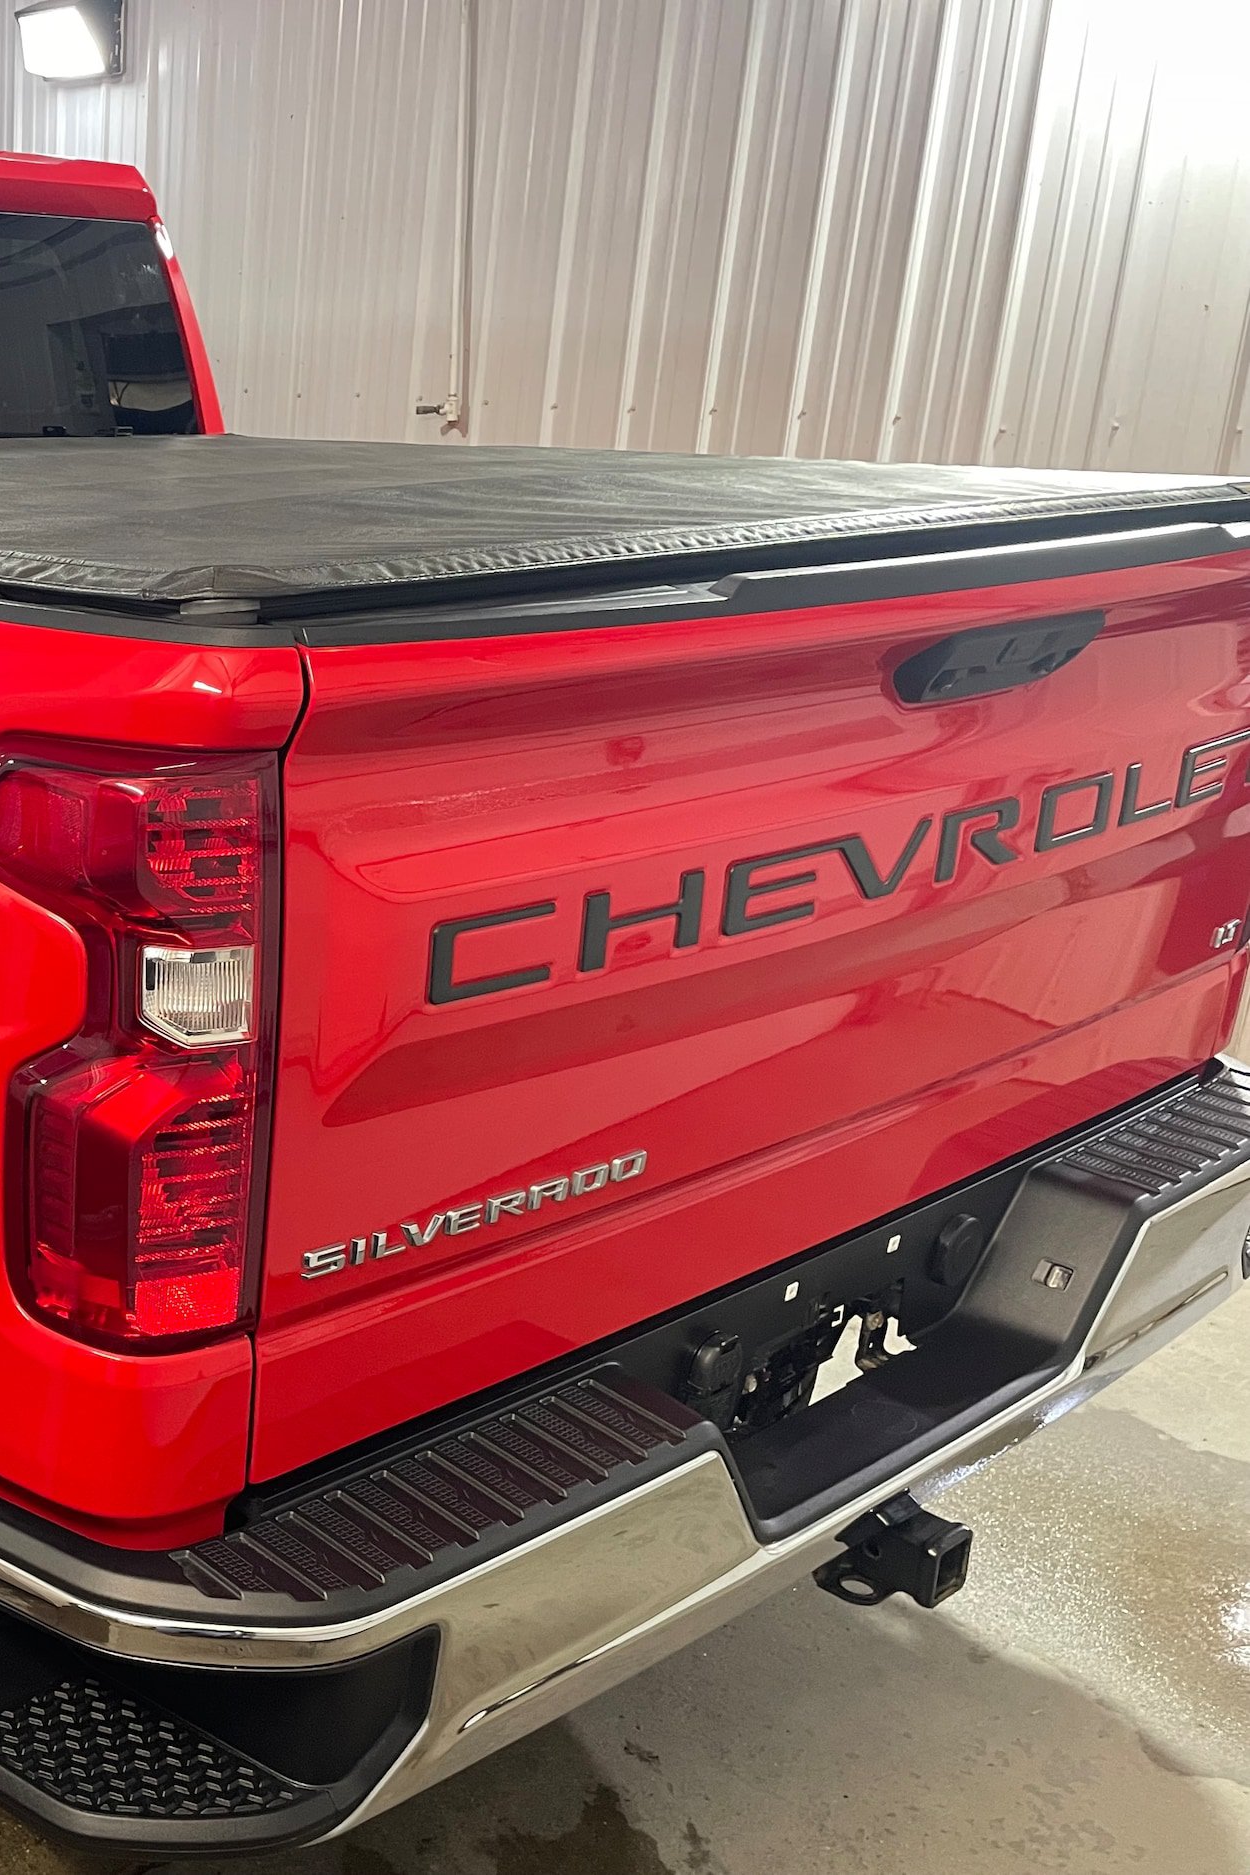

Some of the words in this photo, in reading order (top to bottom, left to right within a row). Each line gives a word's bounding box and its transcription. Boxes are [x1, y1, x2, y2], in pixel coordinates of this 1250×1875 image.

[429, 728, 1250, 1006] CHEVROLE
[1210, 918, 1241, 949] LT
[300, 1148, 647, 1280] SILVERADO
